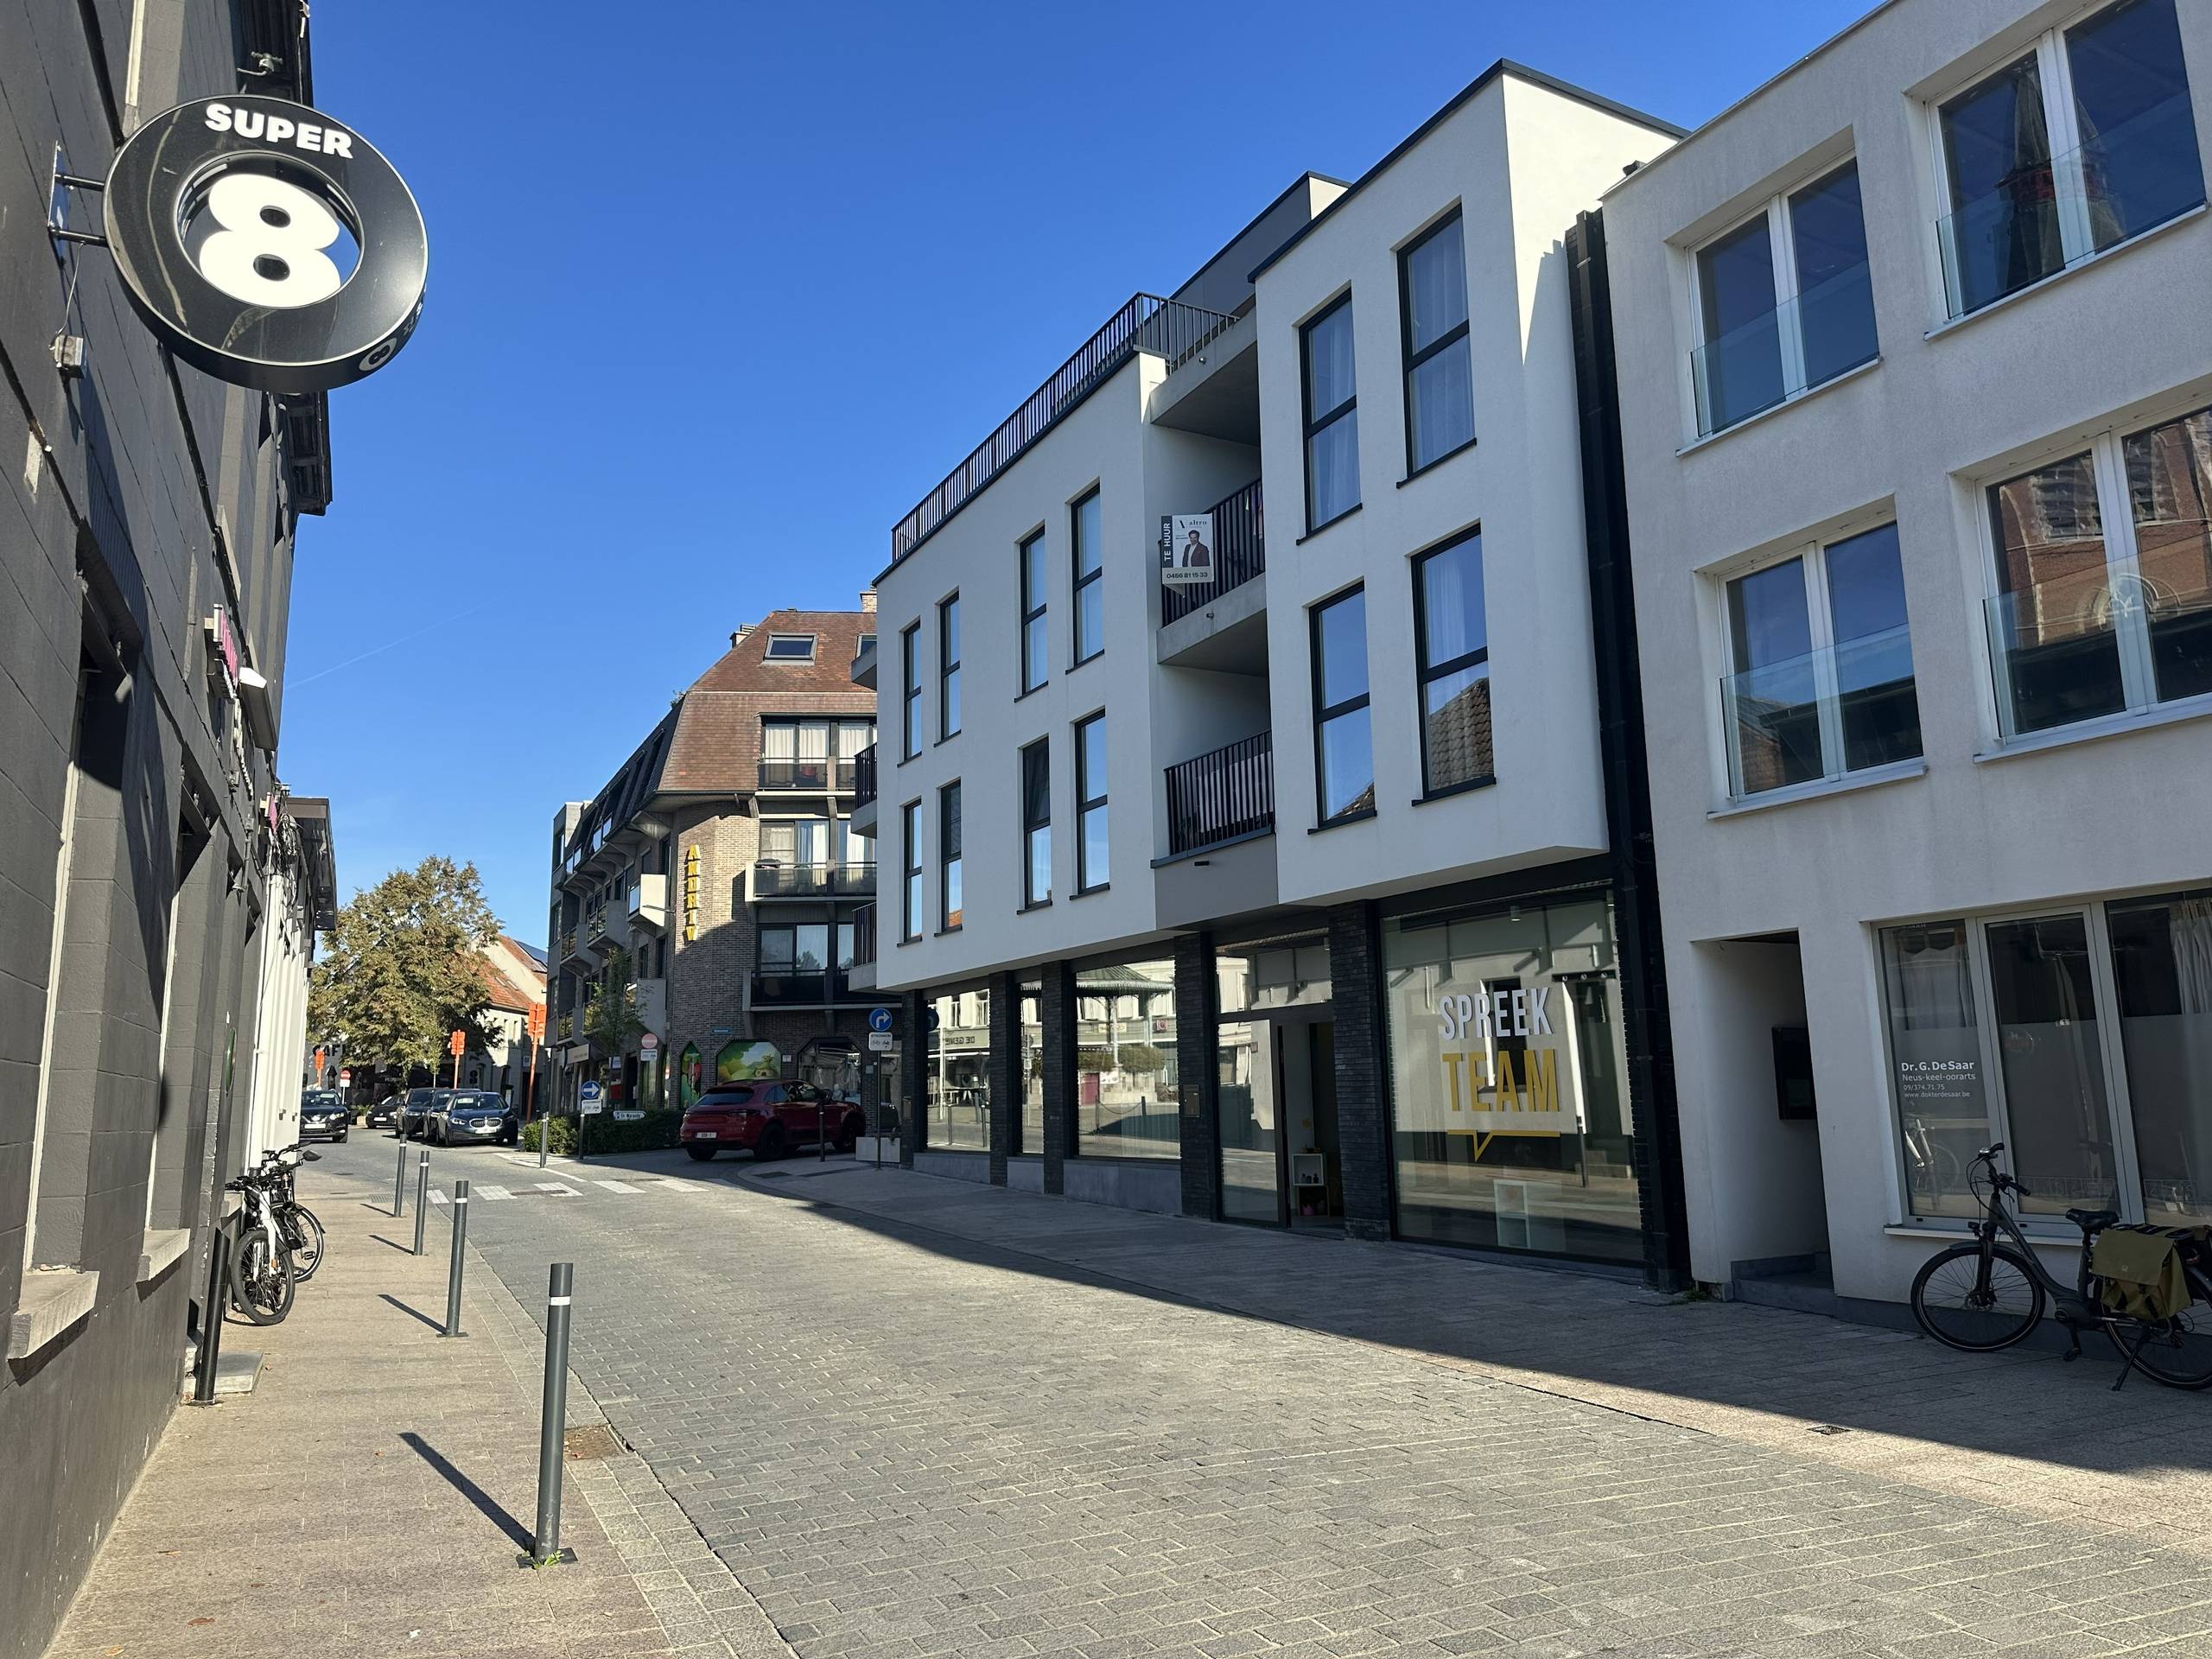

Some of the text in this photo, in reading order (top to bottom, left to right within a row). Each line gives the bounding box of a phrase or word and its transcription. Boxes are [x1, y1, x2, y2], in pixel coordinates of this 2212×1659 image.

[206, 103, 353, 159] SUPER
[199, 173, 342, 309] 8
[1163, 523, 1172, 563] TE HUUR
[1439, 987, 1553, 1040] SPREEK
[1442, 1049, 1560, 1112] TEAM
[1901, 1062, 1918, 1071] Dr.
[1919, 1061, 1930, 1071] G.
[1902, 1073, 1976, 1082] Neus-keel-oorarts
